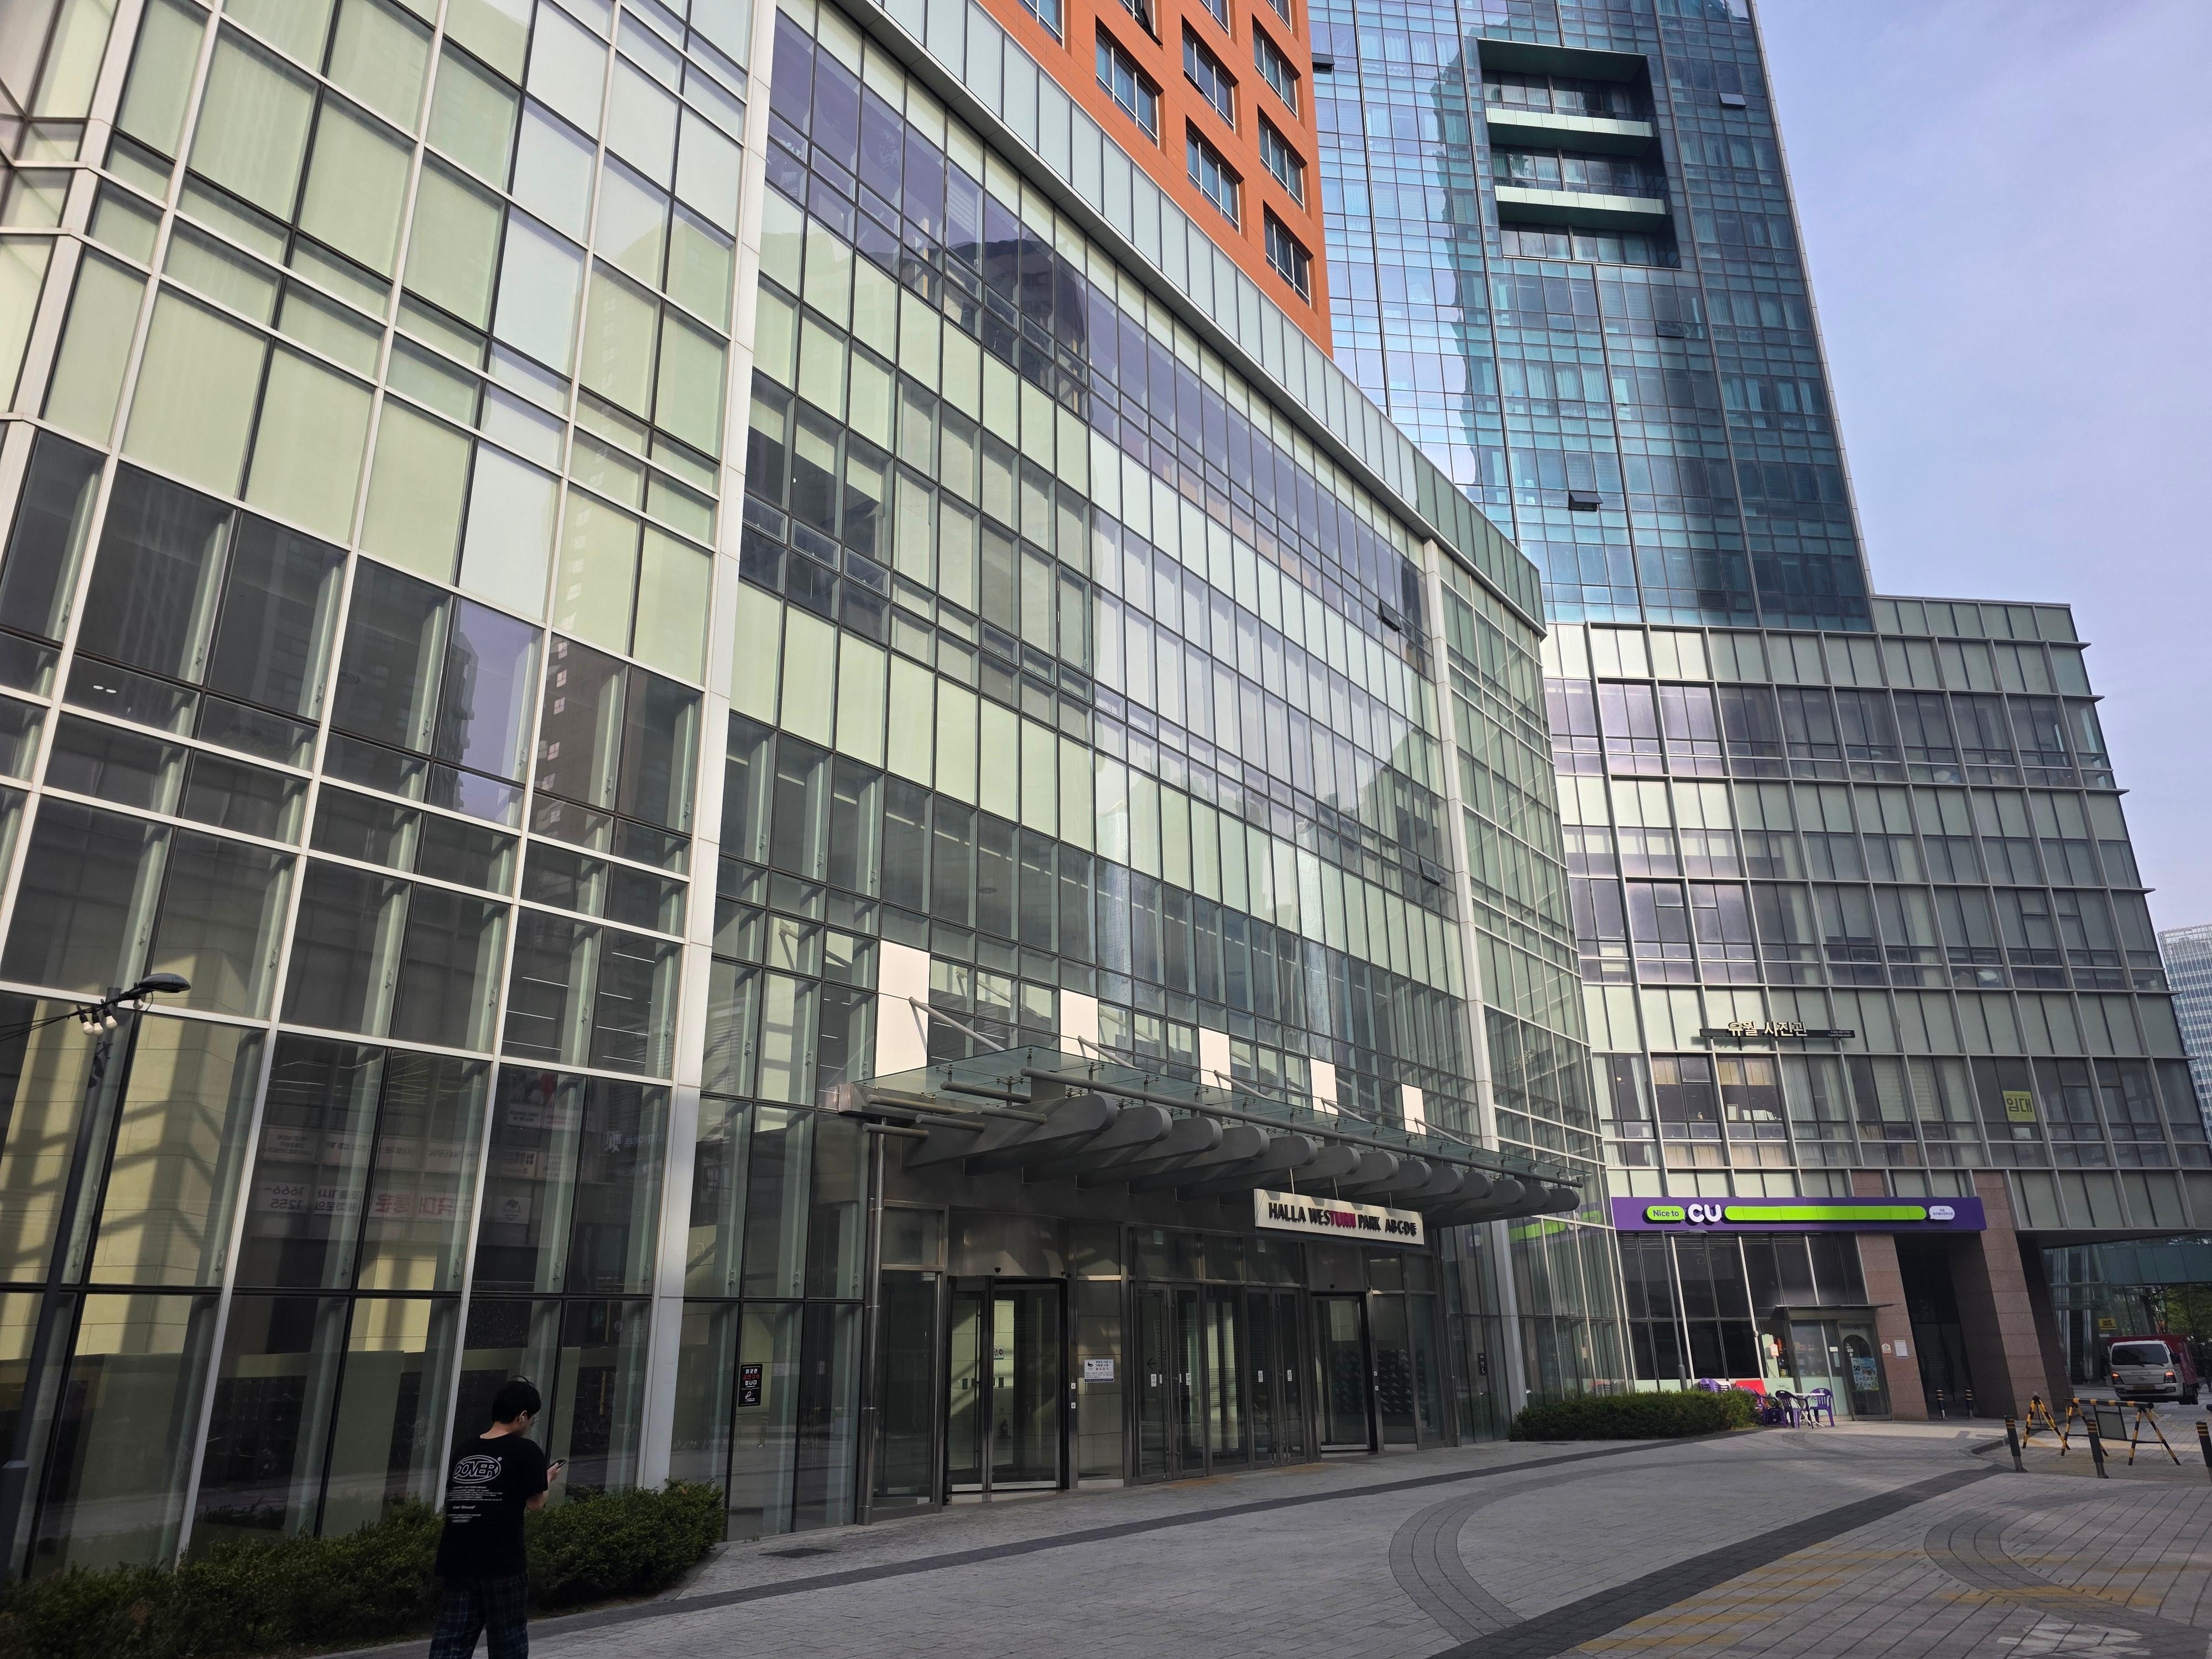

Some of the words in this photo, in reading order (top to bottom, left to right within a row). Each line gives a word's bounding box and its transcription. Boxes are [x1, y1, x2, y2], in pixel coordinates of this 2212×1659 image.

[1728, 1021, 1758, 1036] 유월
[1764, 1021, 1808, 1036] 사진관
[2006, 1098, 2032, 1112] 임대
[1269, 1202, 1306, 1223] HALLA
[1358, 1214, 1381, 1232] PARK
[1688, 1203, 1722, 1223] CU
